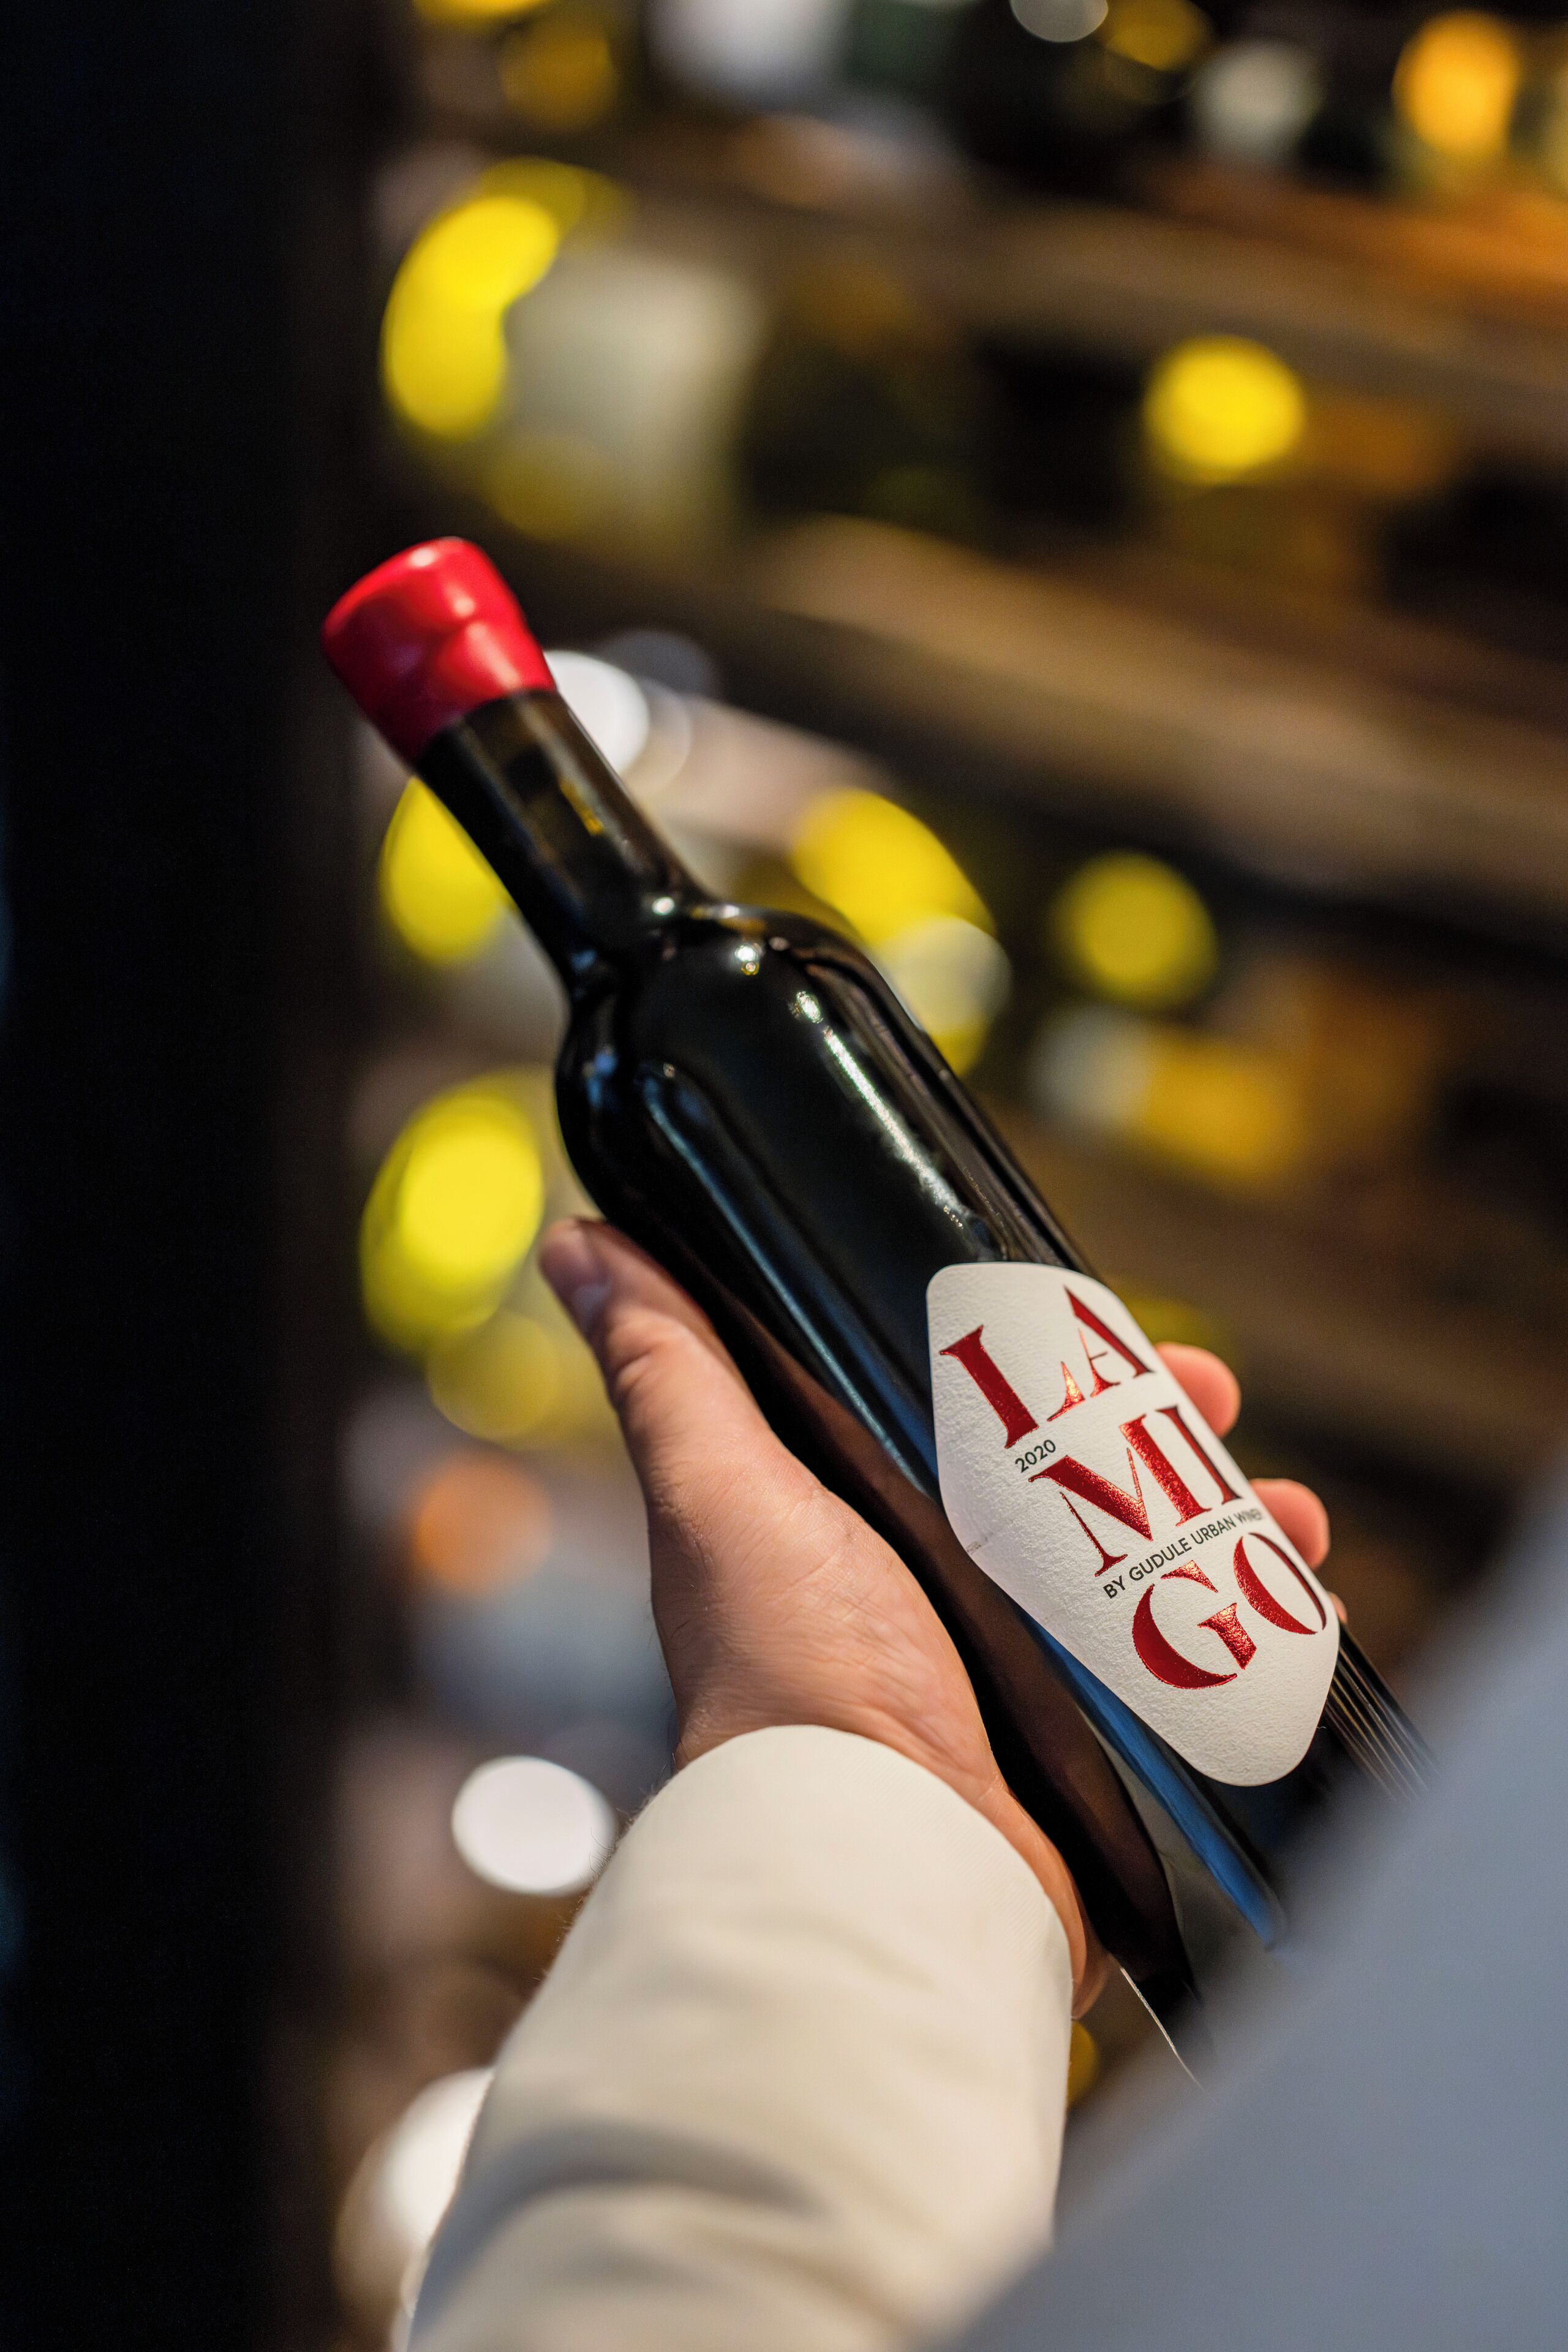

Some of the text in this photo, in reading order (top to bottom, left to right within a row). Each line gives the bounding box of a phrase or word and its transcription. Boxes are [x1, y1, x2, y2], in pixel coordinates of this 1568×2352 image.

[940, 1286, 1155, 1449] LA
[1015, 1439, 1056, 1473] 2020
[1028, 1406, 1242, 1578] MI
[1102, 1575, 1126, 1599] BY
[1129, 1537, 1192, 1581] GUDULE
[1190, 1515, 1237, 1545] URBAN
[1131, 1532, 1327, 1690] GO
